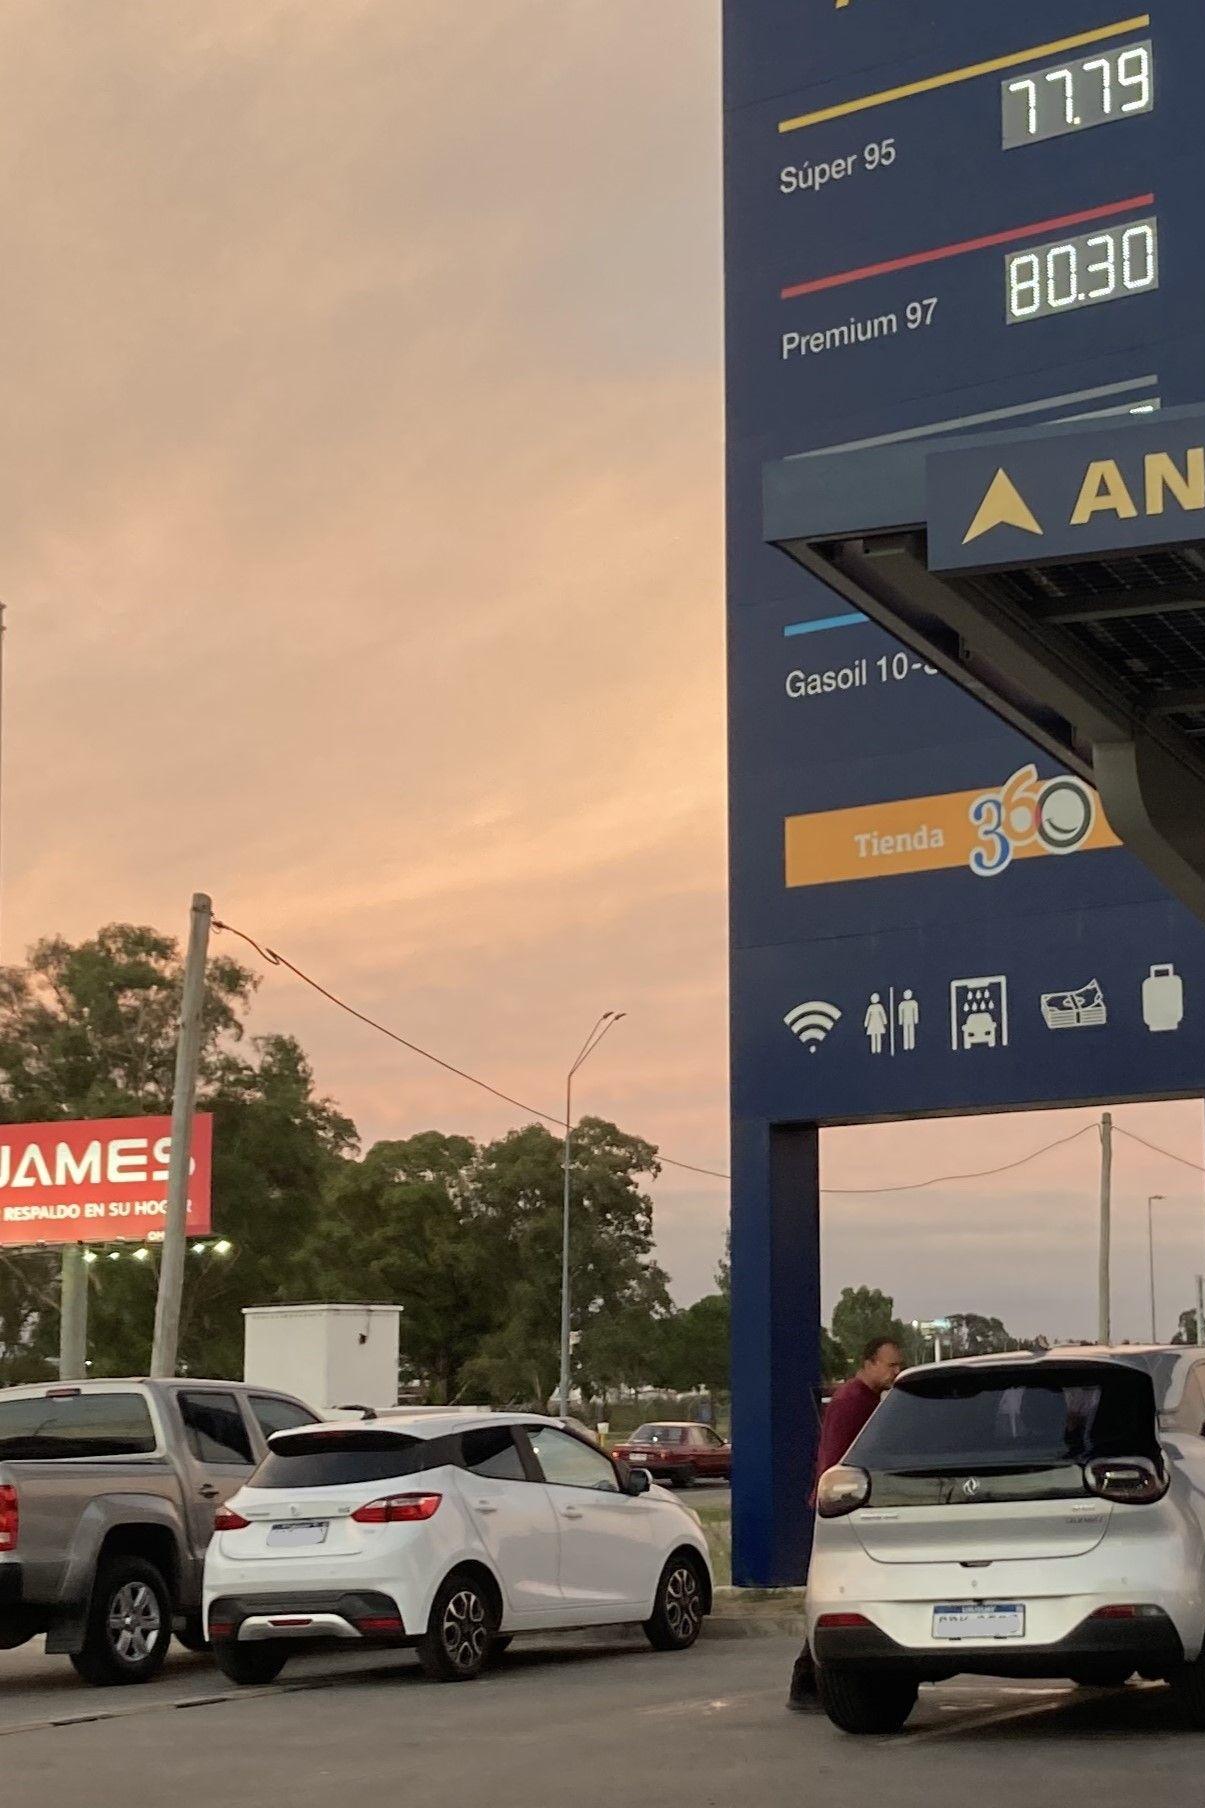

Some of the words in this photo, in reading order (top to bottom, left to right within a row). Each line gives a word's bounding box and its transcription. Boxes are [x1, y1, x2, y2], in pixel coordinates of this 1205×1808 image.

[1009, 47, 1149, 134] 77.79
[779, 154, 857, 194] Súper
[863, 138, 896, 170] 95
[1010, 224, 1154, 317] 80.30
[782, 313, 898, 360] Premium
[905, 297, 938, 330] 97
[785, 658, 867, 698] Gasoil
[853, 824, 945, 858] Tienda
[968, 763, 1096, 877] 360
[4, 1204, 81, 1222] RESPALDO
[84, 1202, 105, 1218] EN
[109, 1201, 131, 1217] SU
